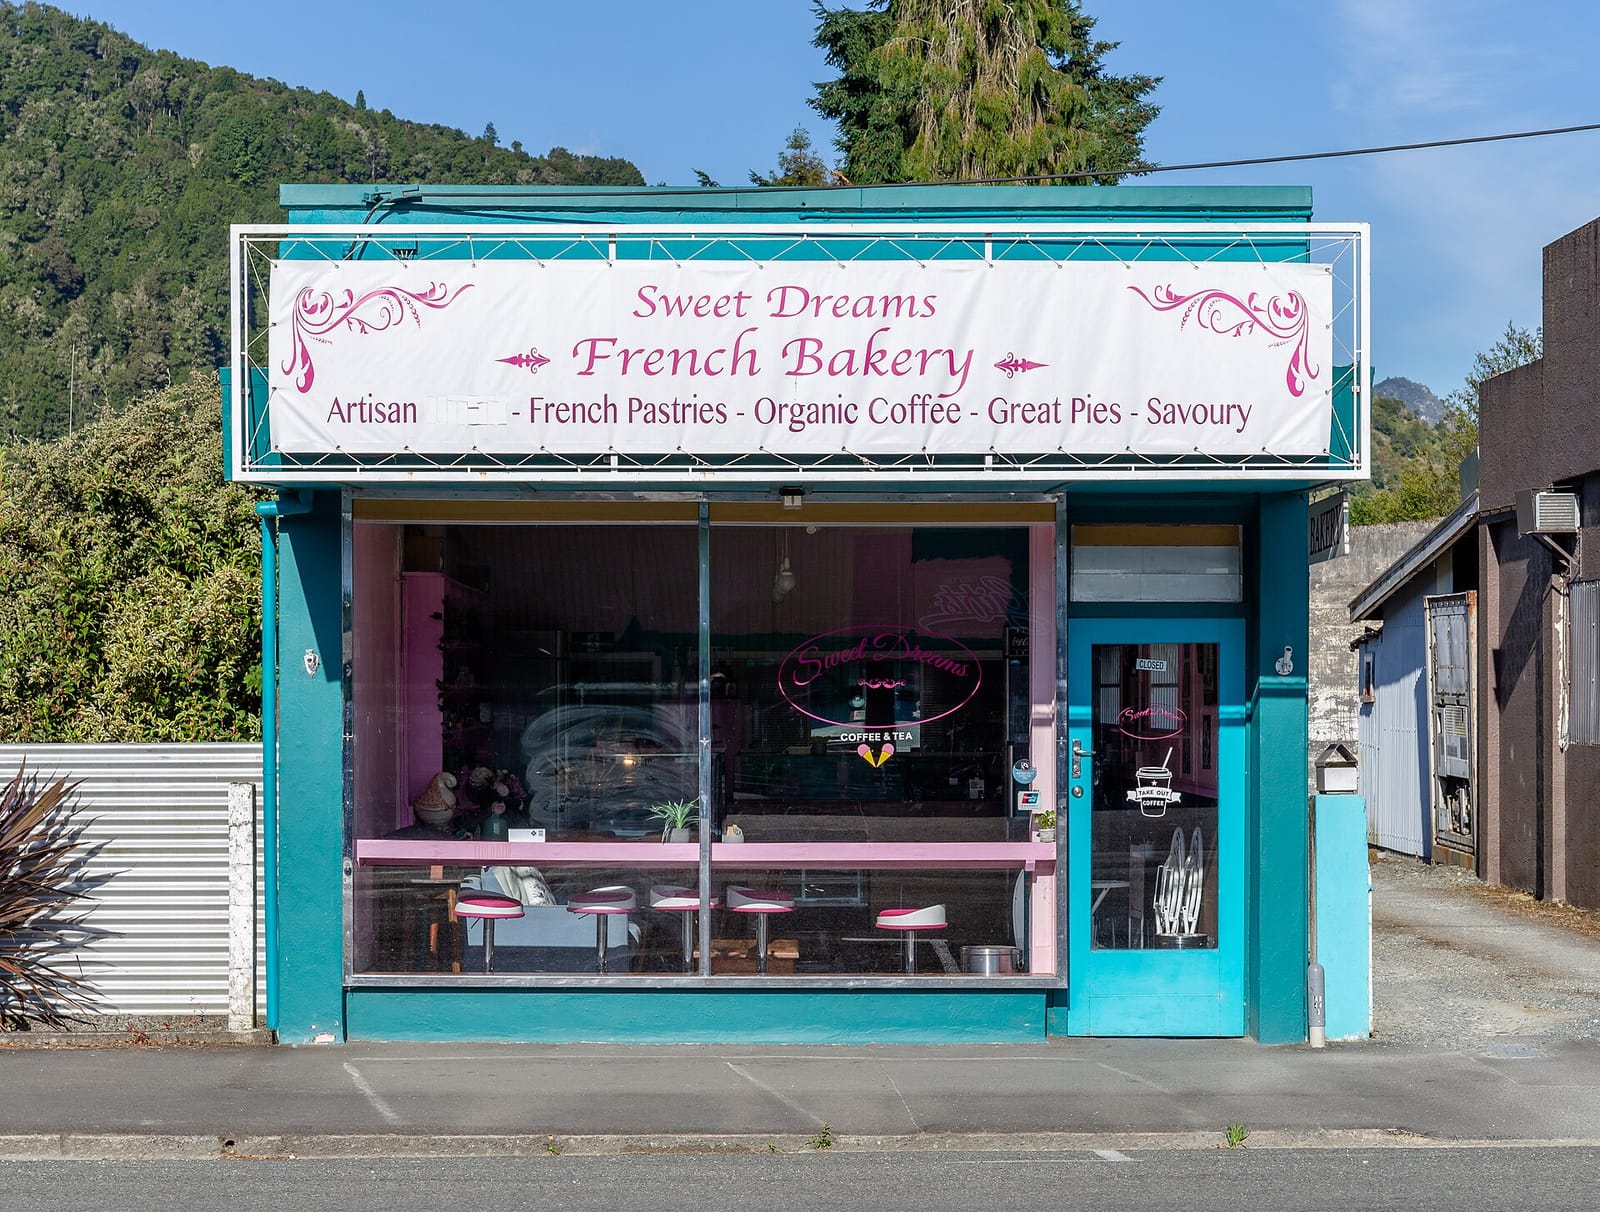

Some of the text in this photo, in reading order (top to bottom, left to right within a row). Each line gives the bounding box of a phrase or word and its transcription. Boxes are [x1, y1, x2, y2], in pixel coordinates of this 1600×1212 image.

[632, 284, 937, 319] Sweet Dreams
[572, 327, 974, 397] French Bakery
[327, 394, 417, 424] Artisan
[530, 394, 617, 425] French
[628, 394, 728, 424] Pastries
[753, 394, 859, 432] Organic
[868, 396, 961, 424] Coffee
[988, 397, 1062, 424] Great
[1071, 394, 1122, 424] Pies
[1147, 398, 1253, 433] Savoury
[1310, 506, 1343, 555] BAKERY
[792, 632, 968, 686] Sweet Dreams
[1139, 659, 1164, 670] CLOSED
[840, 731, 913, 742] COFFEE & TEA
